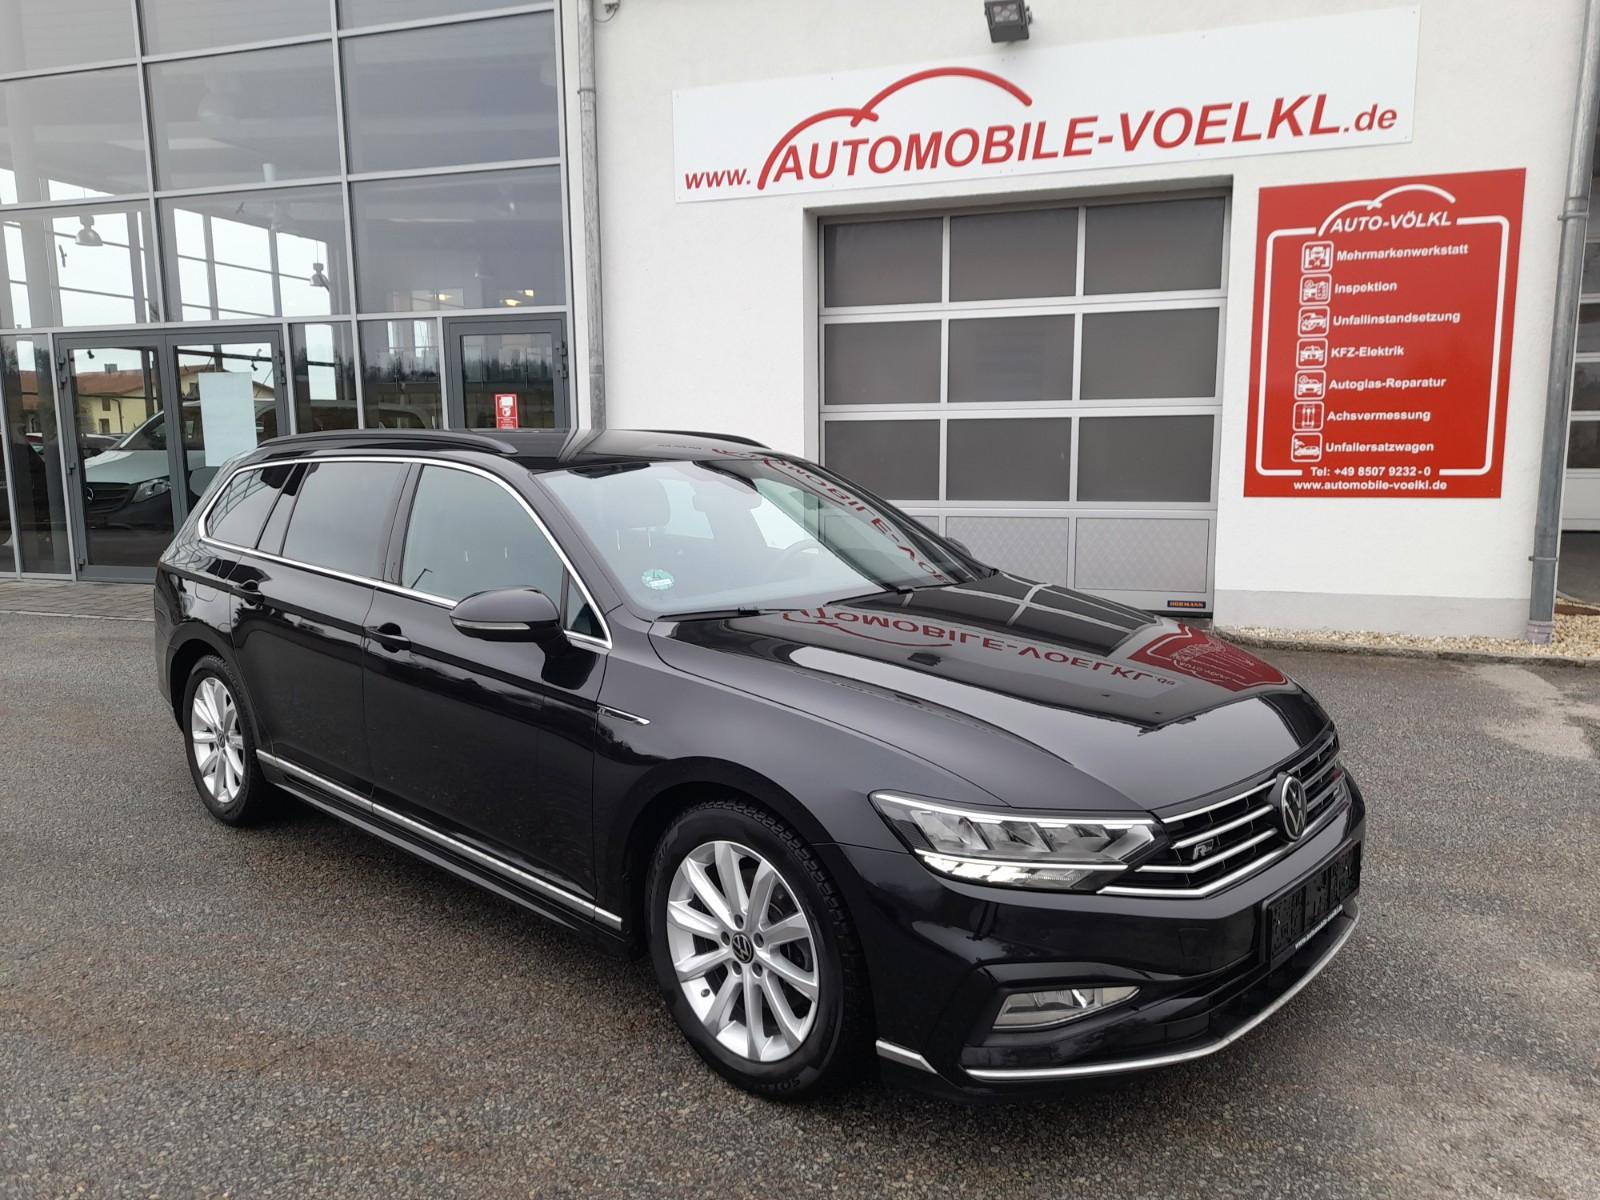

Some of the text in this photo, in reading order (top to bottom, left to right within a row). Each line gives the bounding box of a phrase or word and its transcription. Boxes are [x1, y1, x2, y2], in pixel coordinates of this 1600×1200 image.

[1330, 210, 1452, 233] AUTO-VÖLKL
[1336, 243, 1469, 262] Mehrmarkenwerkstatt
[1334, 281, 1398, 294] Inspektion
[1332, 312, 1461, 326] Unfallinstandsetzung
[1330, 346, 1405, 358] KFZ-Elektrik
[1328, 377, 1447, 391] Autoglas-Reparatur
[1326, 410, 1432, 422] Achsvermessung
[1325, 442, 1435, 454] Unfallersatzwagen
[1310, 466, 1331, 477] Tel:
[1334, 466, 1355, 477] +49
[1357, 466, 1386, 477] 8507
[1293, 479, 1448, 491] www.automobile-voelkl.de
